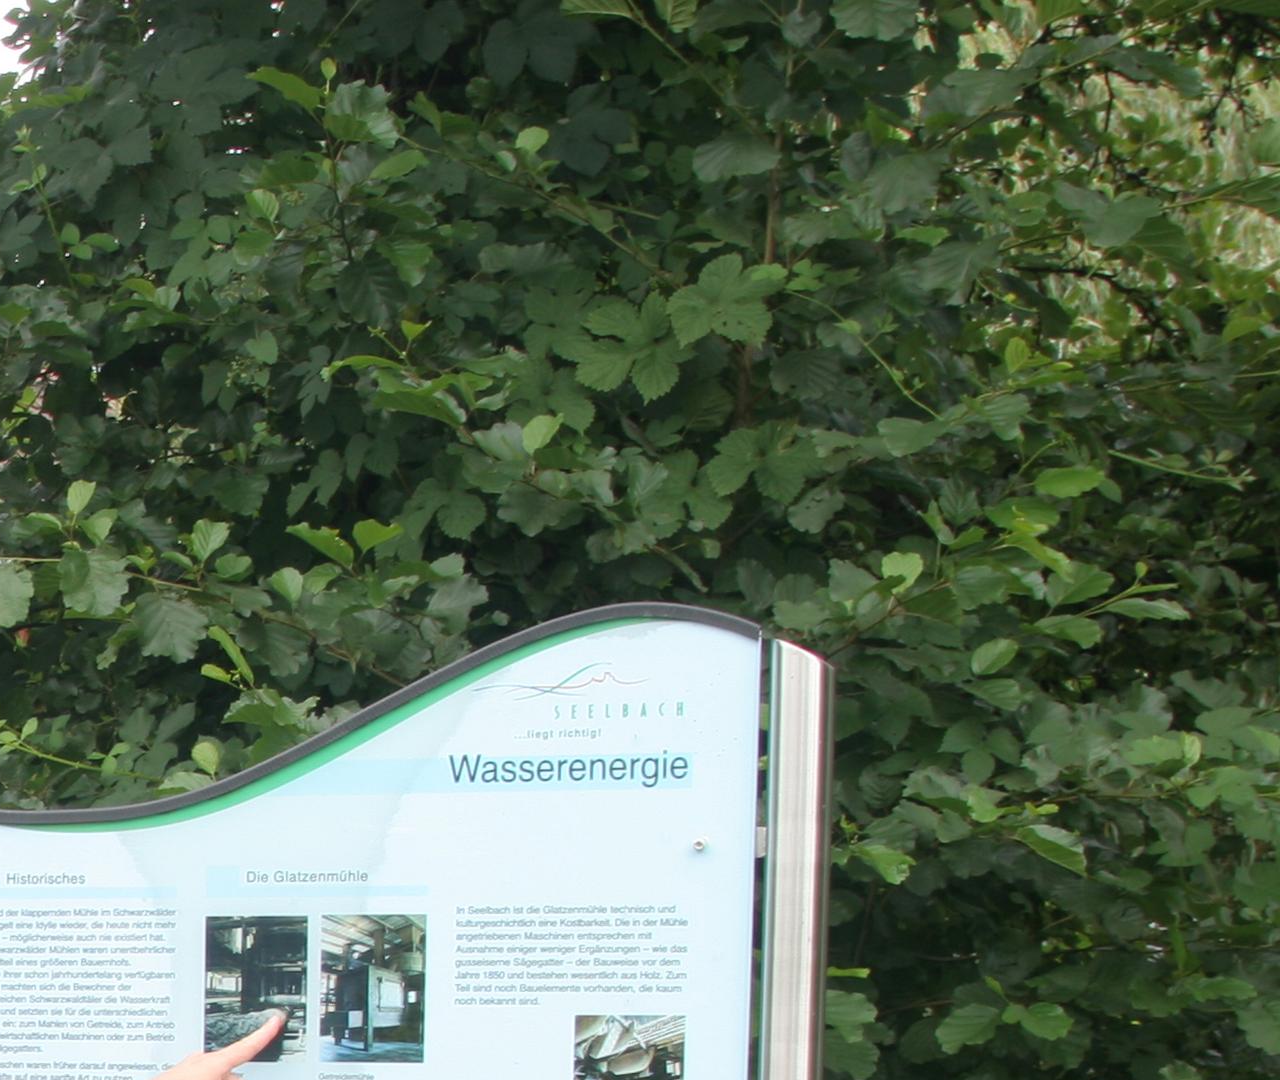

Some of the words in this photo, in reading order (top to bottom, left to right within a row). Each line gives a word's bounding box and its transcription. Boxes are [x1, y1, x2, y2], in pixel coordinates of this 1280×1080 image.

[554, 702, 684, 720] SEELBACH
[449, 751, 689, 788] Wasserenergie
[6, 872, 86, 884] Historisches
[246, 870, 269, 883] Die
[273, 870, 369, 883] Glatzenmühle
